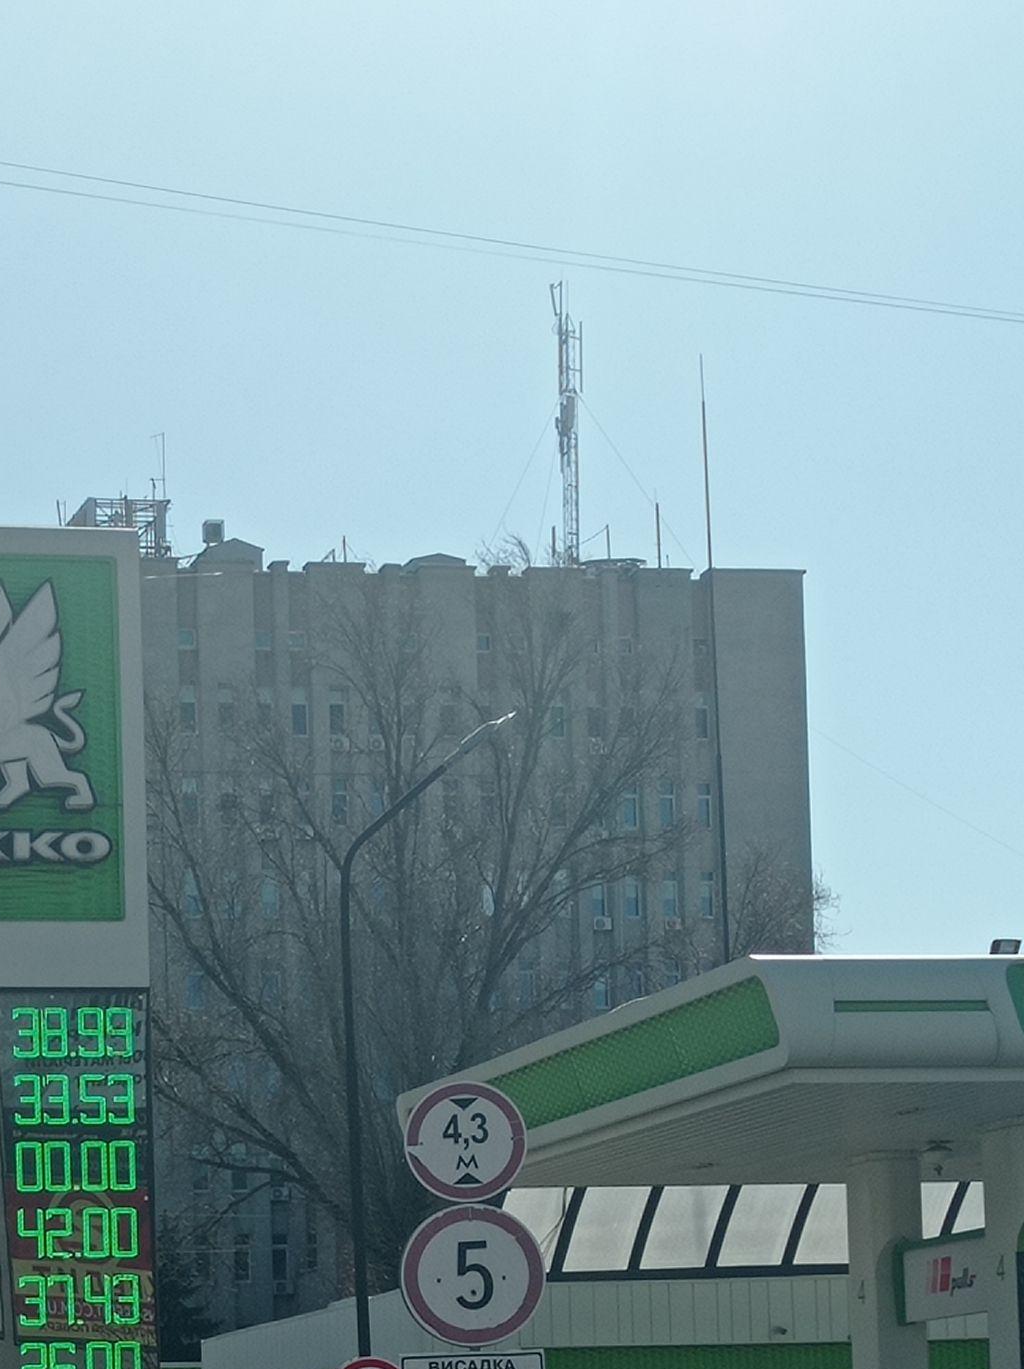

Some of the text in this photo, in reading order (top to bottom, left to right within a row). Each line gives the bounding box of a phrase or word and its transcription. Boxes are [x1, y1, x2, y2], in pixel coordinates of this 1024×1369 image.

[12, 1007, 134, 1058] 38.99
[14, 1074, 136, 1124] 33.53
[442, 1112, 489, 1150] 4,3
[15, 1141, 137, 1192] 00.00
[17, 1207, 139, 1258] 42.00
[18, 1274, 140, 1326] 37.43
[456, 1240, 494, 1310] 5
